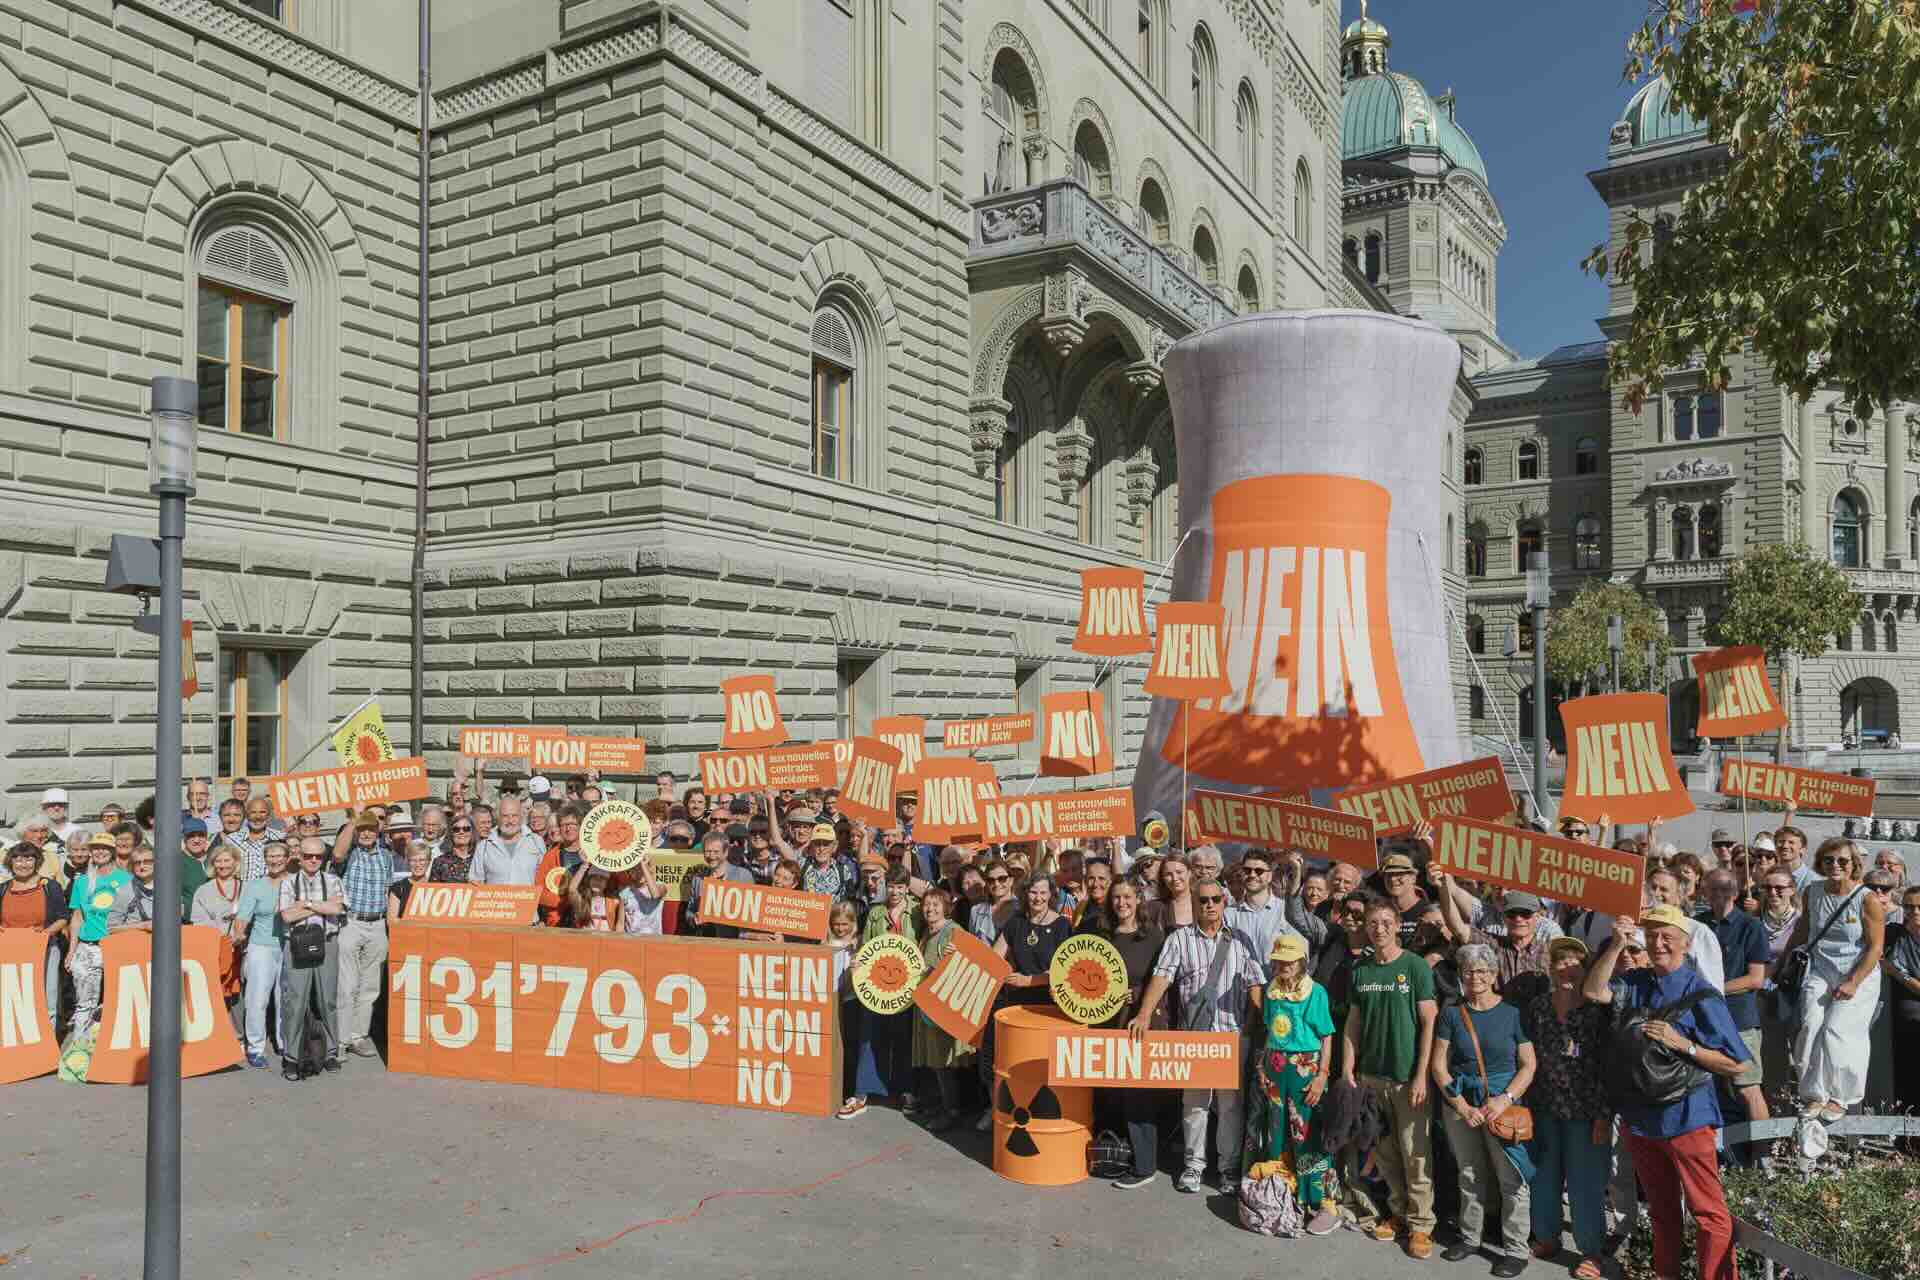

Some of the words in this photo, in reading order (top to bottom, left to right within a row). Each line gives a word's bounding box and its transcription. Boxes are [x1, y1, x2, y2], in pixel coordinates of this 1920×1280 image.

[1086, 588, 1142, 635] NON
[1194, 546, 1383, 716] NEIN
[1158, 624, 1219, 678] NEIN
[731, 690, 775, 733] NO
[1704, 665, 1772, 720] NEIN
[464, 732, 513, 754] NEIN
[535, 739, 586, 766] NON
[946, 721, 989, 745] NEIN
[1049, 710, 1100, 758] NO
[705, 753, 767, 788] NON
[1576, 721, 1671, 795] NEIN
[275, 773, 350, 813] NEIN
[352, 771, 370, 785] zu
[373, 766, 420, 782] neuen
[356, 784, 390, 800] AKW
[847, 756, 893, 812] NEIN
[923, 777, 978, 825] NON
[1422, 782, 1441, 798] zu
[1444, 769, 1497, 794] neuen
[1727, 764, 1795, 799] NEIN
[1800, 775, 1817, 788] zu
[1821, 779, 1869, 797] neuen
[1799, 789, 1833, 806] AKW
[583, 804, 642, 843] ATOMKRAFT?
[986, 801, 1053, 837] NON
[1202, 797, 1281, 841] NEIN
[1288, 813, 1307, 828] zu
[1312, 817, 1367, 840] neuen
[1428, 796, 1467, 818] AKW
[594, 854, 621, 868] NEIN
[624, 831, 648, 865] DANKE
[1290, 830, 1330, 851] AKW
[1440, 823, 1532, 884] NEIN
[1540, 847, 1562, 865] zu
[1567, 857, 1635, 885] neuen
[656, 865, 682, 874] NEUE
[1538, 873, 1585, 898] AKW
[409, 888, 472, 917] NON
[704, 884, 762, 922] NON
[738, 953, 828, 1002] NEIN
[1057, 939, 1124, 985] ATOMKRAFT?
[110, 960, 214, 1049] NO
[857, 982, 879, 1007] NON
[929, 951, 997, 1026] NON
[1054, 983, 1077, 1013] NEIN
[1079, 994, 1119, 1020] DANKE
[738, 1008, 821, 1056] NON
[1055, 1035, 1142, 1080] NEIN
[1149, 1042, 1170, 1058] zu
[1174, 1042, 1232, 1059] neuen
[1149, 1062, 1191, 1081] AKW
[738, 1060, 791, 1106] NO
